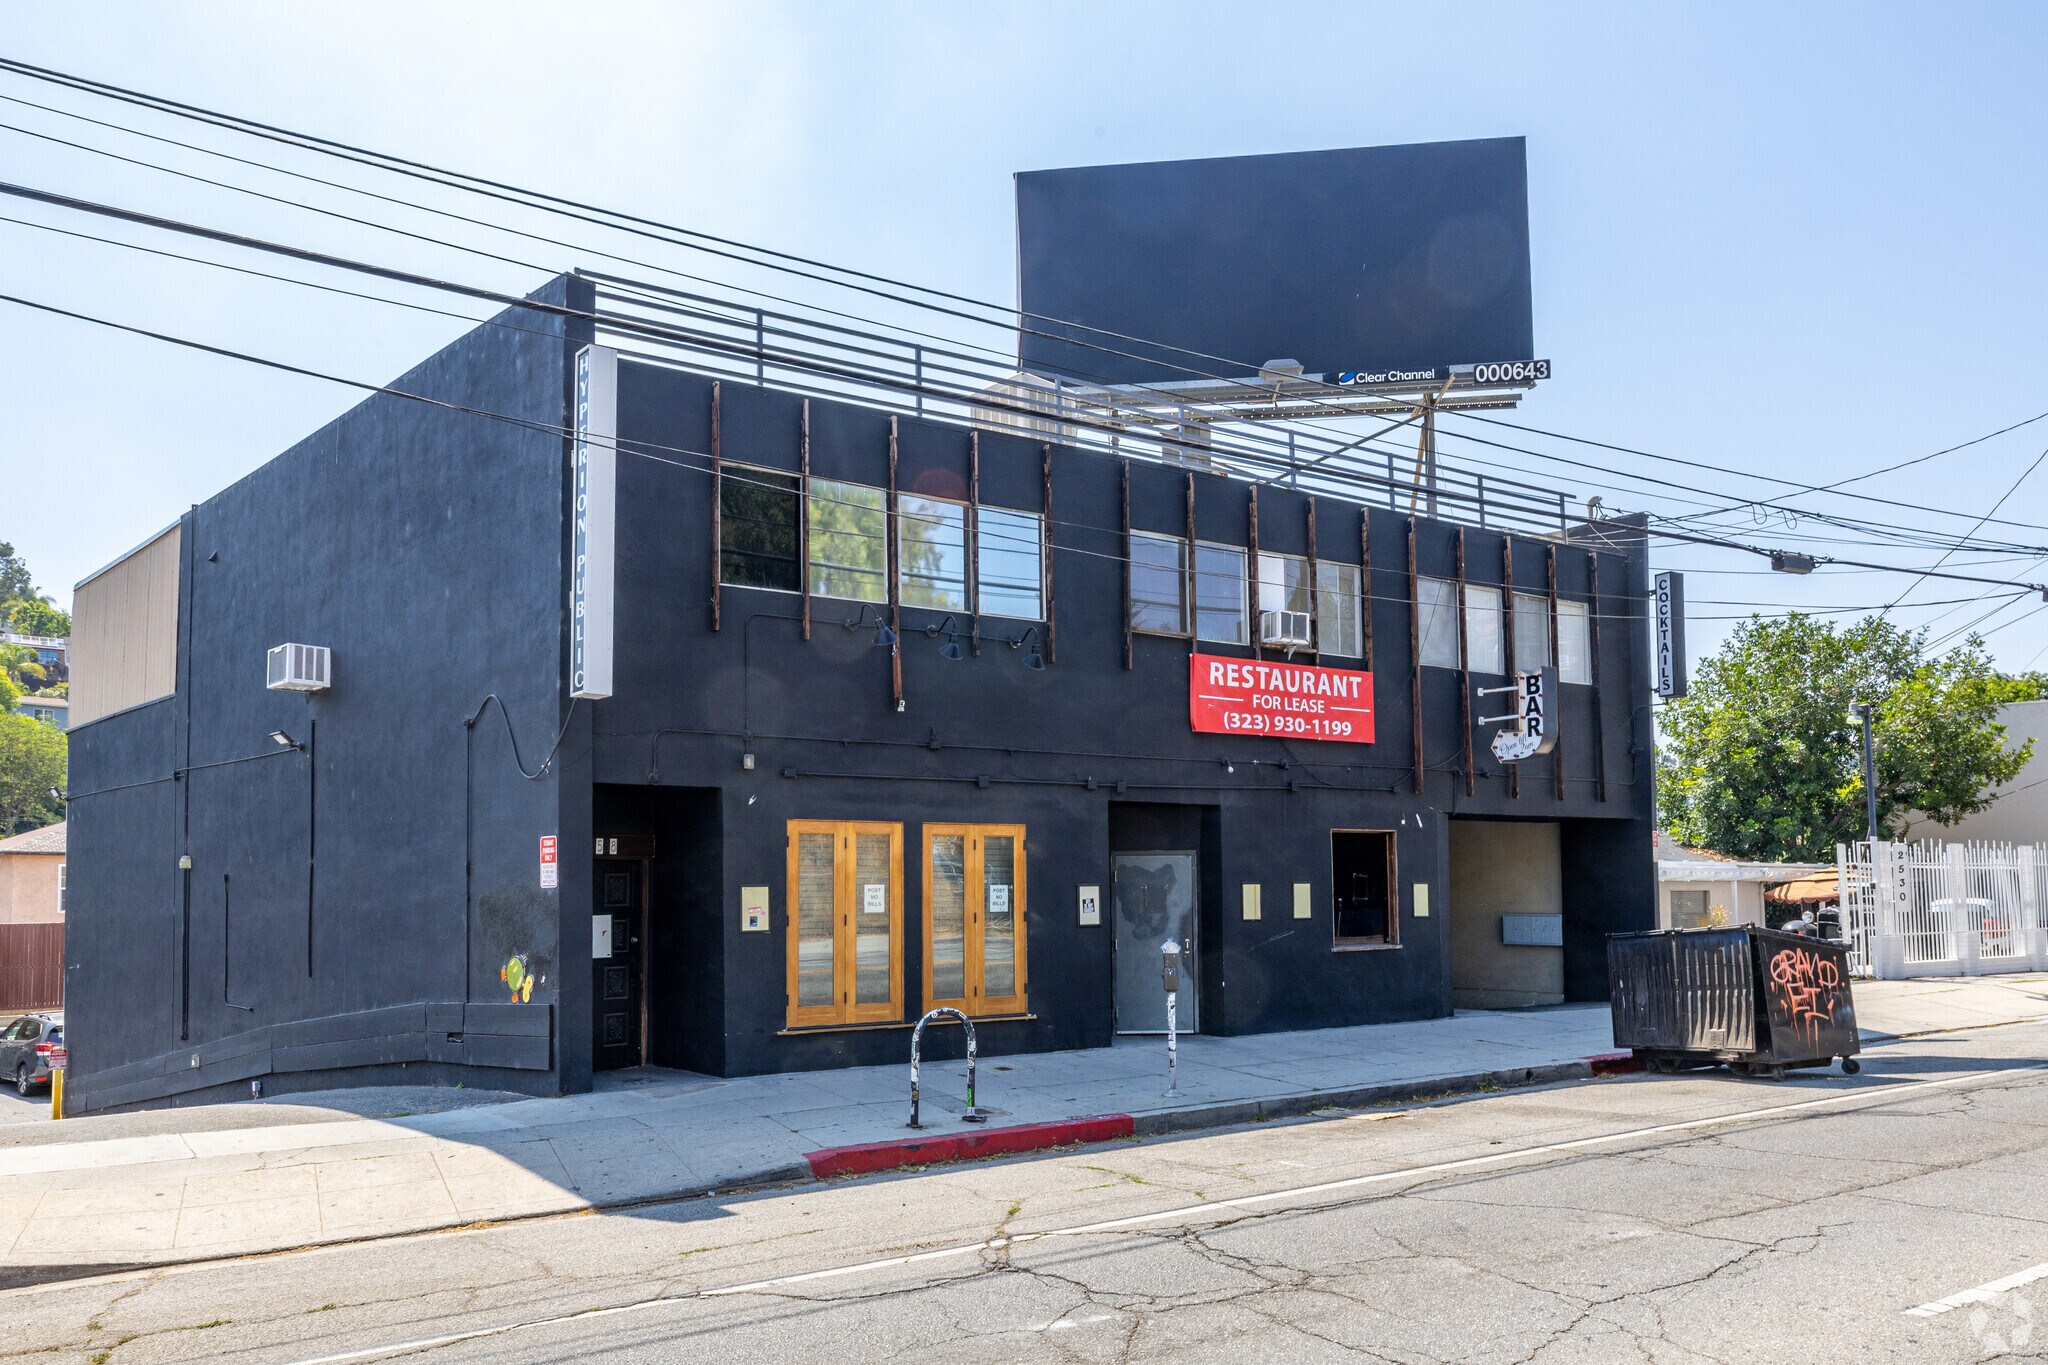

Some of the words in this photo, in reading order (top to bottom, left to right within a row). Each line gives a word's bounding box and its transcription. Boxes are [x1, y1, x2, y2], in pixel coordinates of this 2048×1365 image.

[1356, 372, 1386, 383] Clear
[1387, 368, 1435, 381] Channel
[1475, 361, 1548, 383] 000643
[576, 355, 589, 536] HYPERION
[574, 554, 585, 688] PUBLIC
[1658, 579, 1671, 691] COCKTAILS
[1209, 661, 1362, 698] RESTAURANT
[1253, 694, 1281, 710] FOR
[1284, 698, 1325, 714] LEASE
[1525, 675, 1543, 738] BAR
[1223, 711, 1270, 732] (323)
[1274, 716, 1352, 736] 930-1199
[1499, 742, 1517, 755] Open
[1898, 850, 1906, 901] 2530
